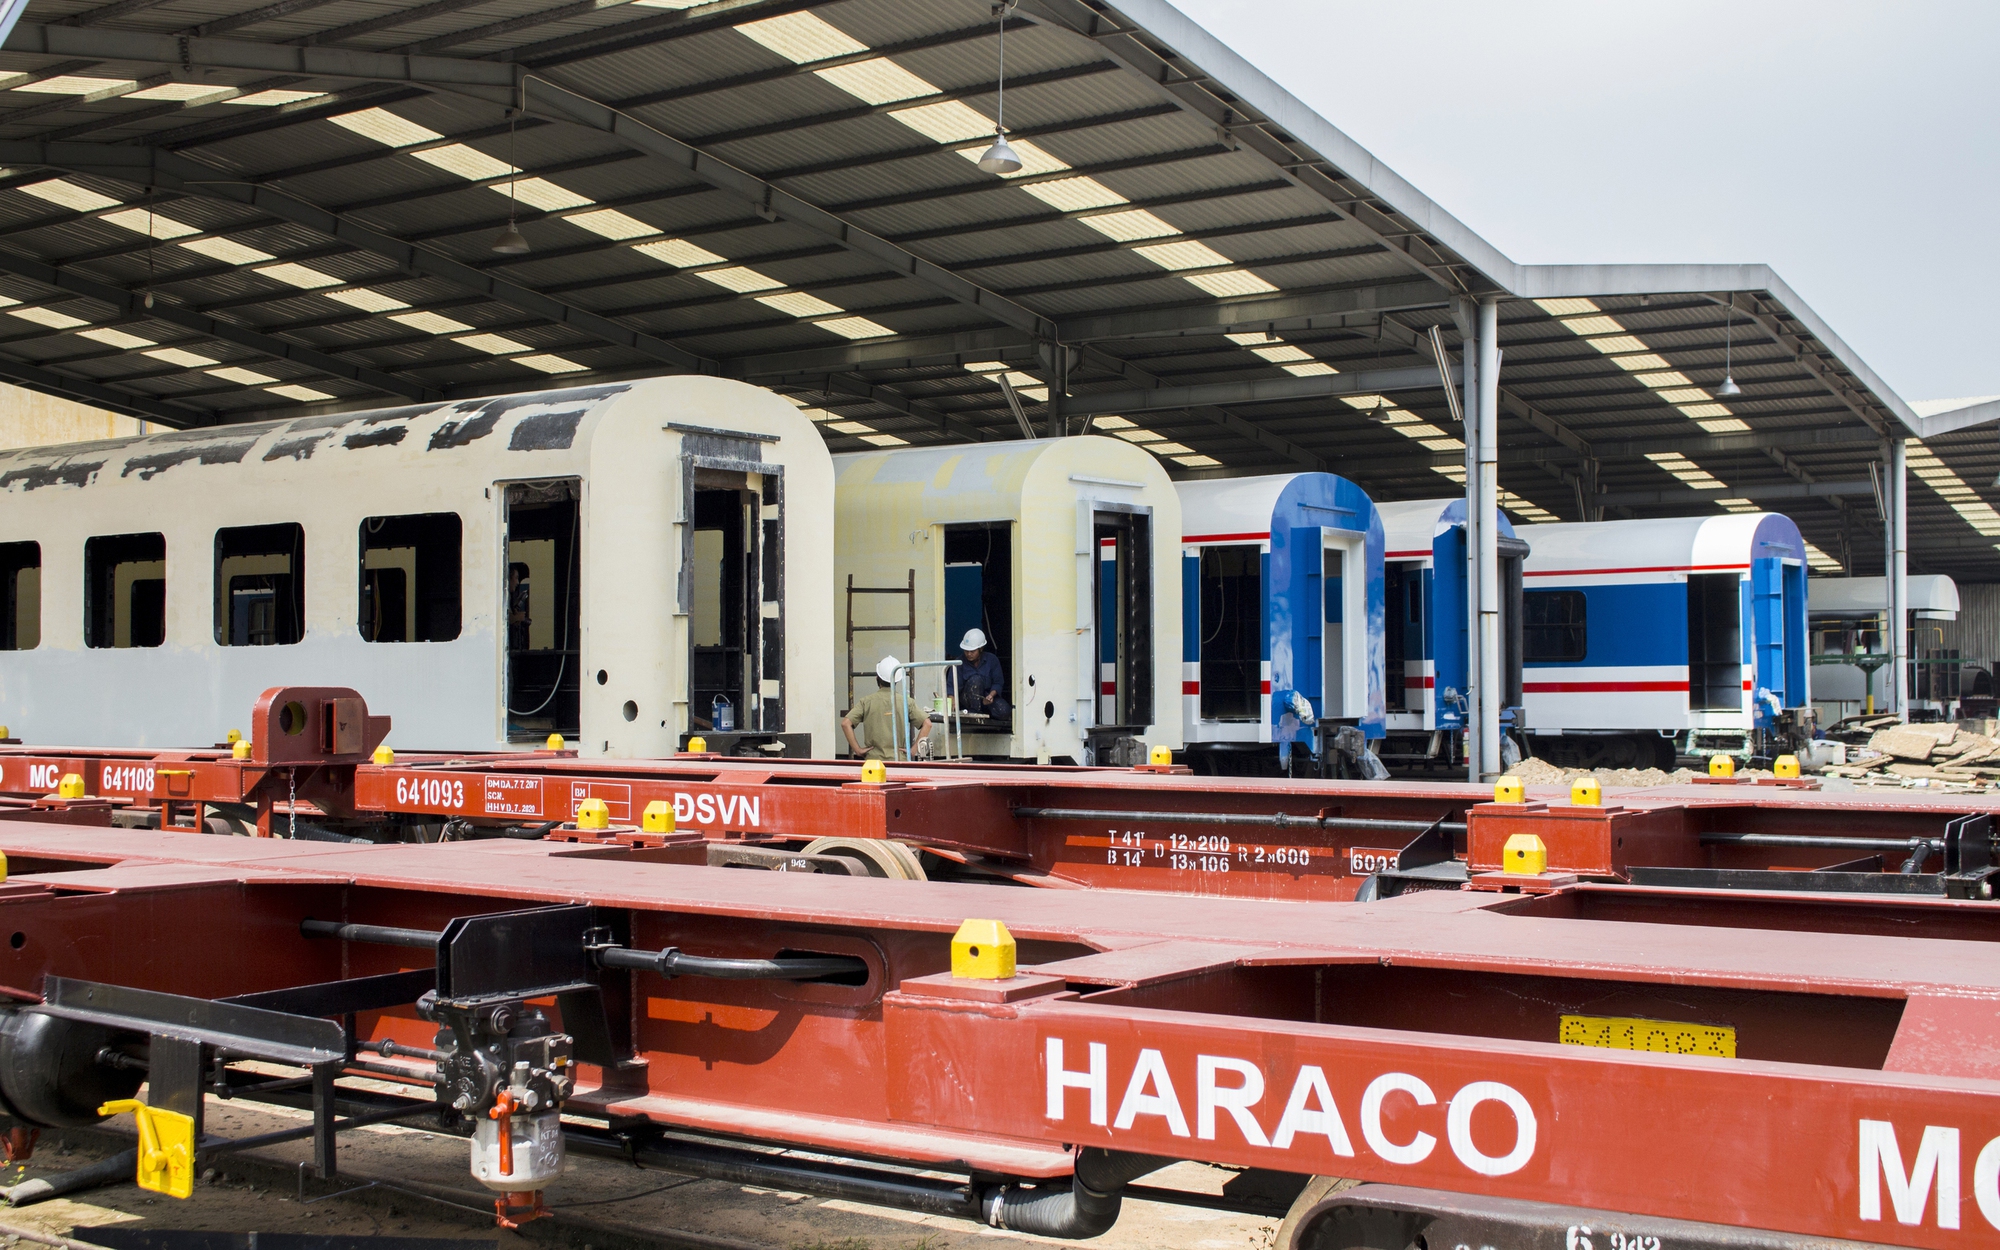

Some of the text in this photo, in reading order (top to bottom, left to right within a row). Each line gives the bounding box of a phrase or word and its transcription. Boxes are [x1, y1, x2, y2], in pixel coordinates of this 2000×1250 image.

[30, 764, 59, 788] MC
[103, 765, 155, 792] 641108
[396, 777, 464, 808] 641093
[673, 792, 760, 826] ĐSVN
[1108, 829, 1117, 844] T
[1238, 846, 1248, 862] R
[790, 858, 807, 868] 942
[1045, 1036, 1538, 1176] HARACO
